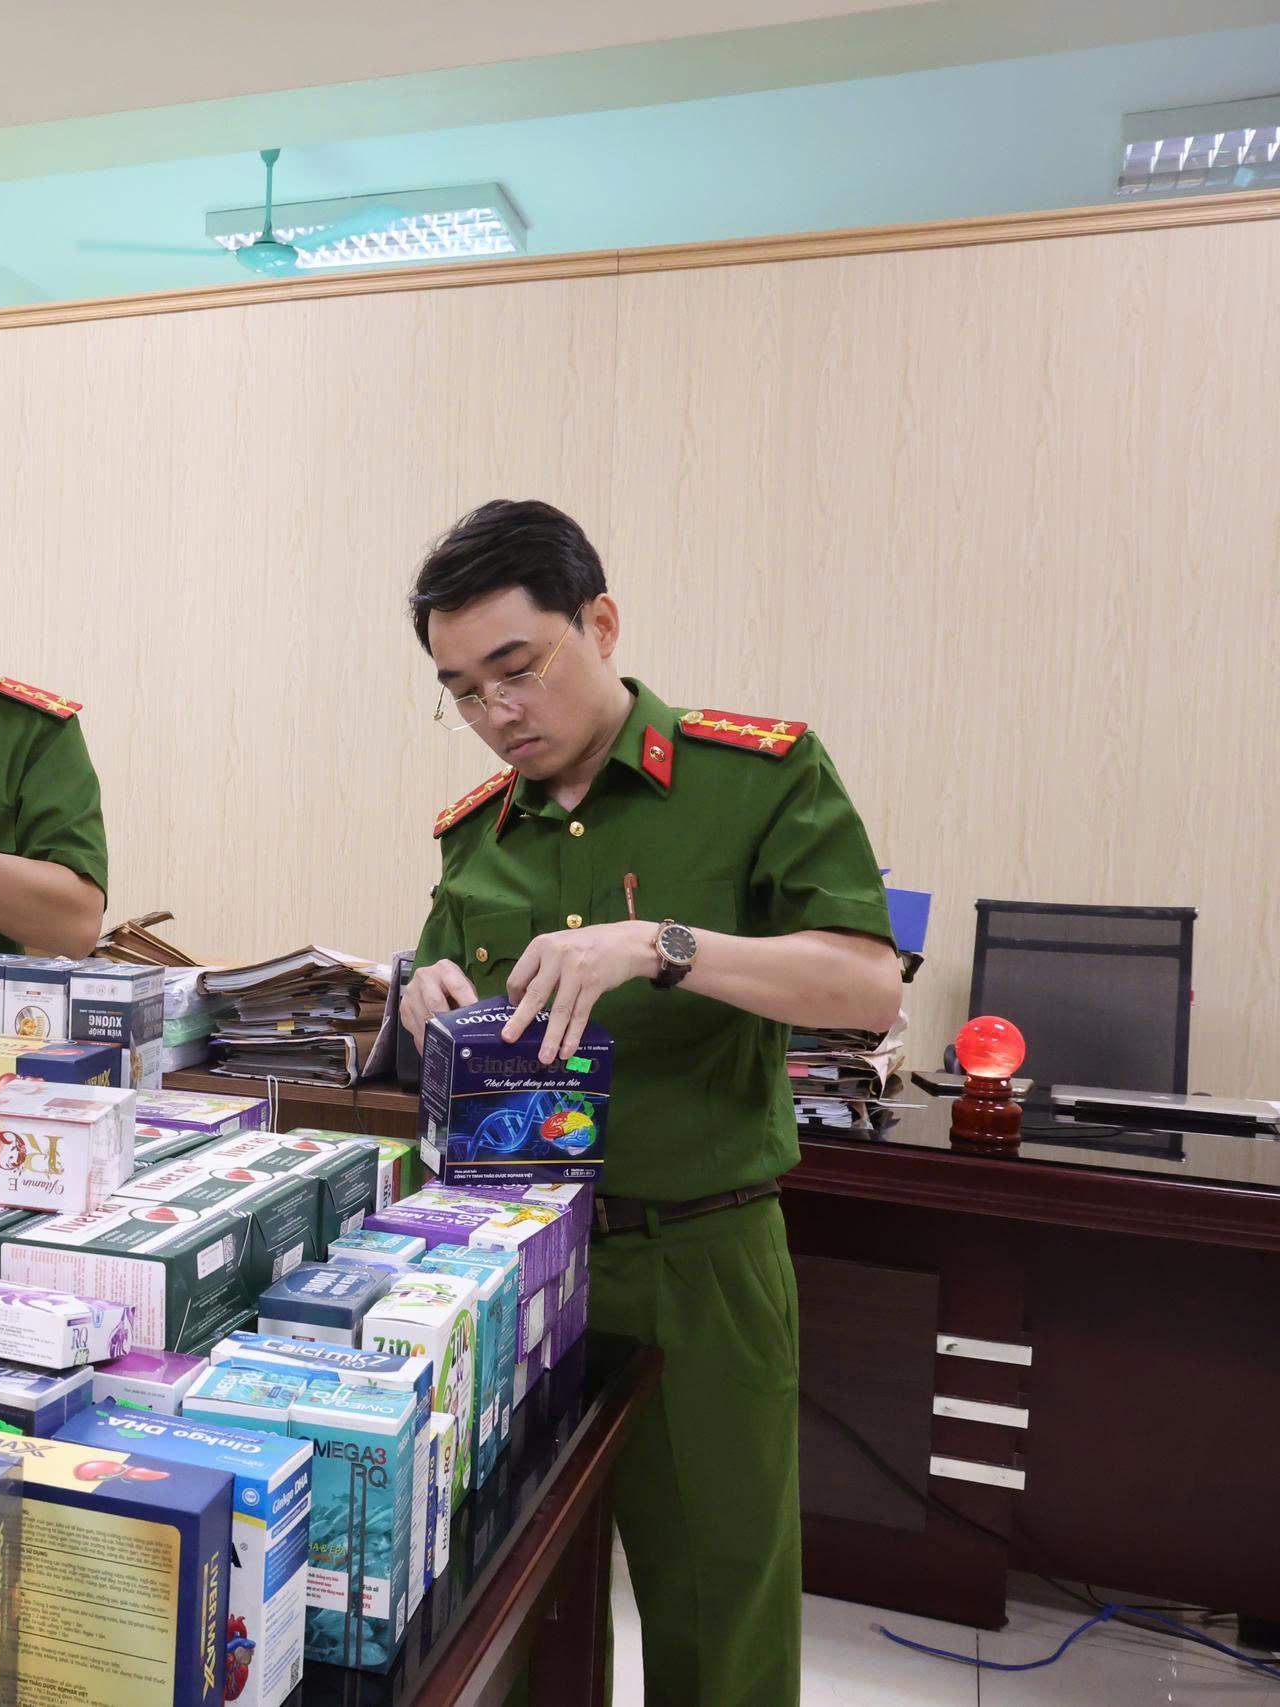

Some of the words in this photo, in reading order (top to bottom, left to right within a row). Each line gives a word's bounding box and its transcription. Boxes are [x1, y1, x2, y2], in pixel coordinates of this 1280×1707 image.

[8, 1177, 18, 1191] E
[23, 1179, 65, 1196] Vitamin
[71, 1327, 88, 1350] RQ
[108, 1415, 166, 1436] DHA
[173, 1428, 263, 1454] Ginkgo
[272, 1489, 294, 1514] Ginkgo
[207, 1551, 220, 1623] LIVER
[202, 1625, 216, 1701] MAX
